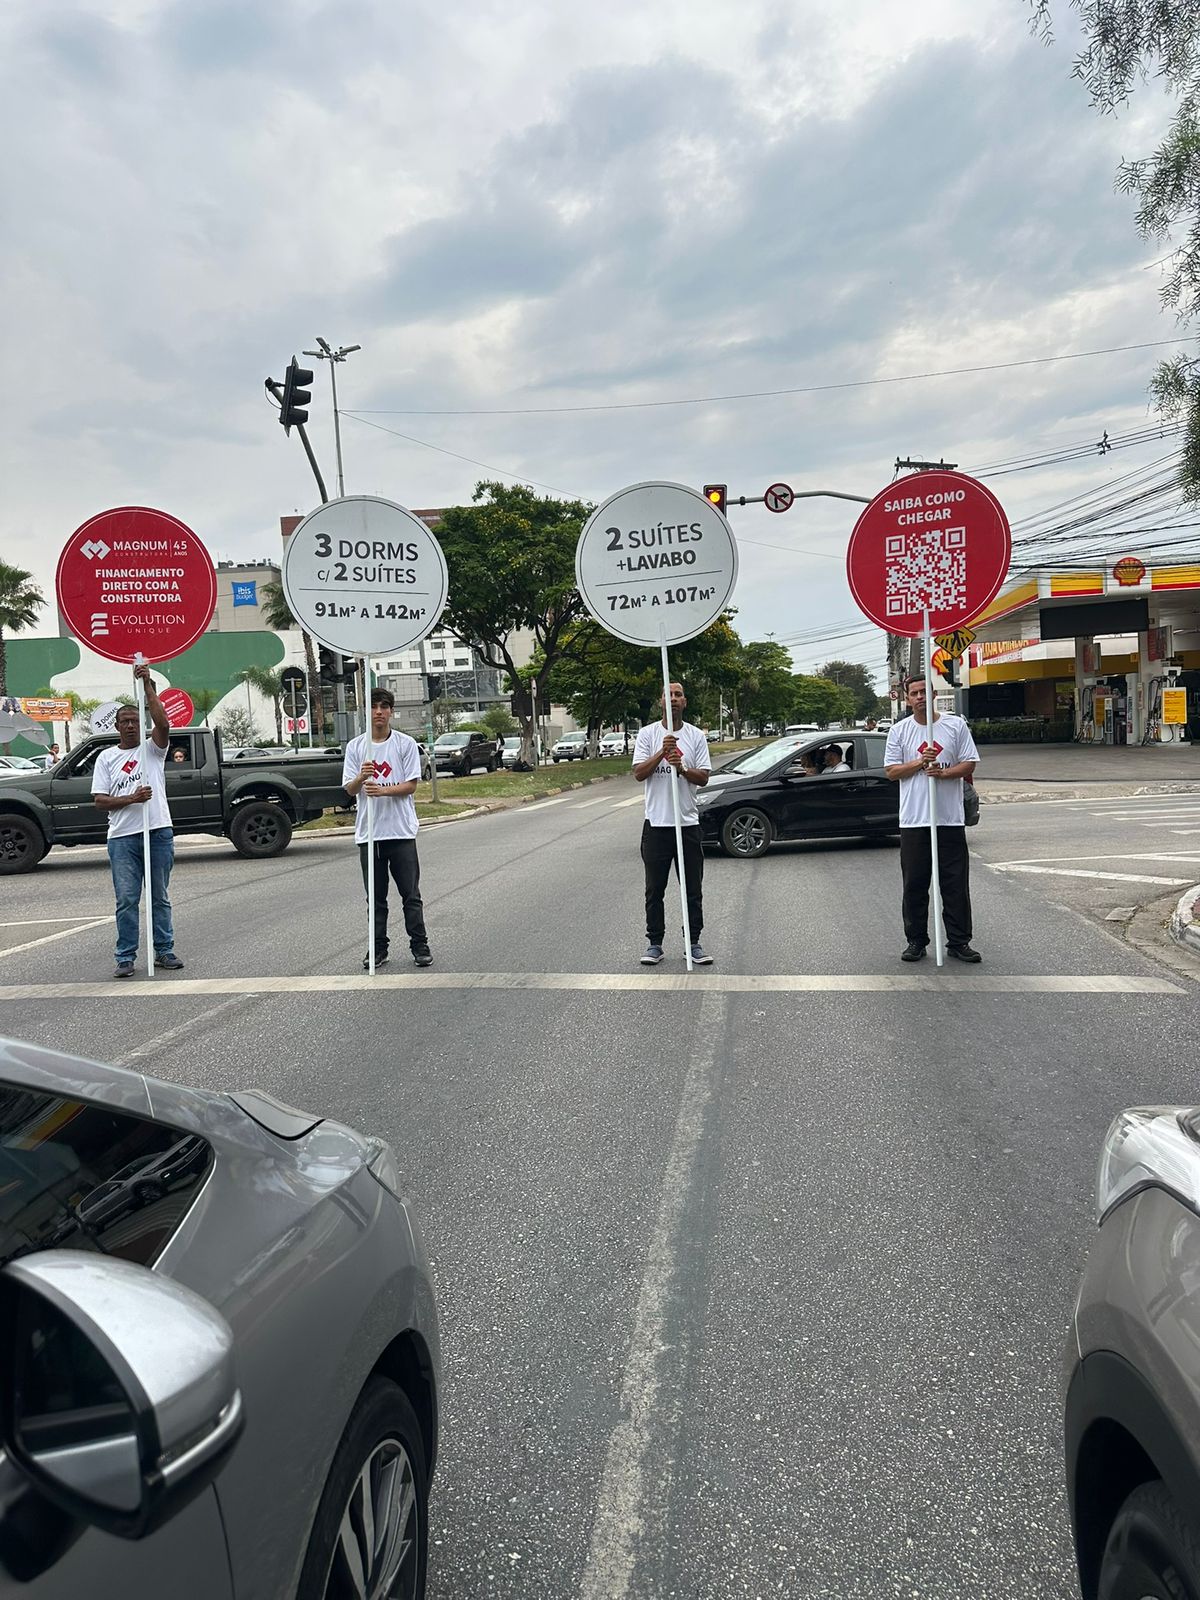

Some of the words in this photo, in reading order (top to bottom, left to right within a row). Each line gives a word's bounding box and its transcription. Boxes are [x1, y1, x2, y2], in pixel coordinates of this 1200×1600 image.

[884, 496, 923, 512] SAIBA
[925, 489, 966, 505] COMO
[897, 508, 952, 526] CHEGAR
[605, 527, 624, 551] 2
[628, 522, 703, 549] SUÍTES
[113, 541, 168, 550] MAGNUM
[173, 541, 187, 550] 45
[314, 533, 332, 558] 3
[339, 540, 419, 562] DORMS
[616, 549, 697, 572] +LAVABO
[95, 568, 184, 578] FINANCIAMENTO
[334, 562, 348, 581] 2
[352, 563, 417, 584] SUÍTES
[102, 581, 143, 591] DIRETO
[145, 581, 169, 590] COM
[170, 581, 179, 590] A
[237, 586, 251, 595] ibis
[100, 593, 182, 603] CONSTRUTORA
[651, 596, 661, 606] A
[361, 608, 370, 618] A
[112, 614, 185, 625] EVOLUTION
